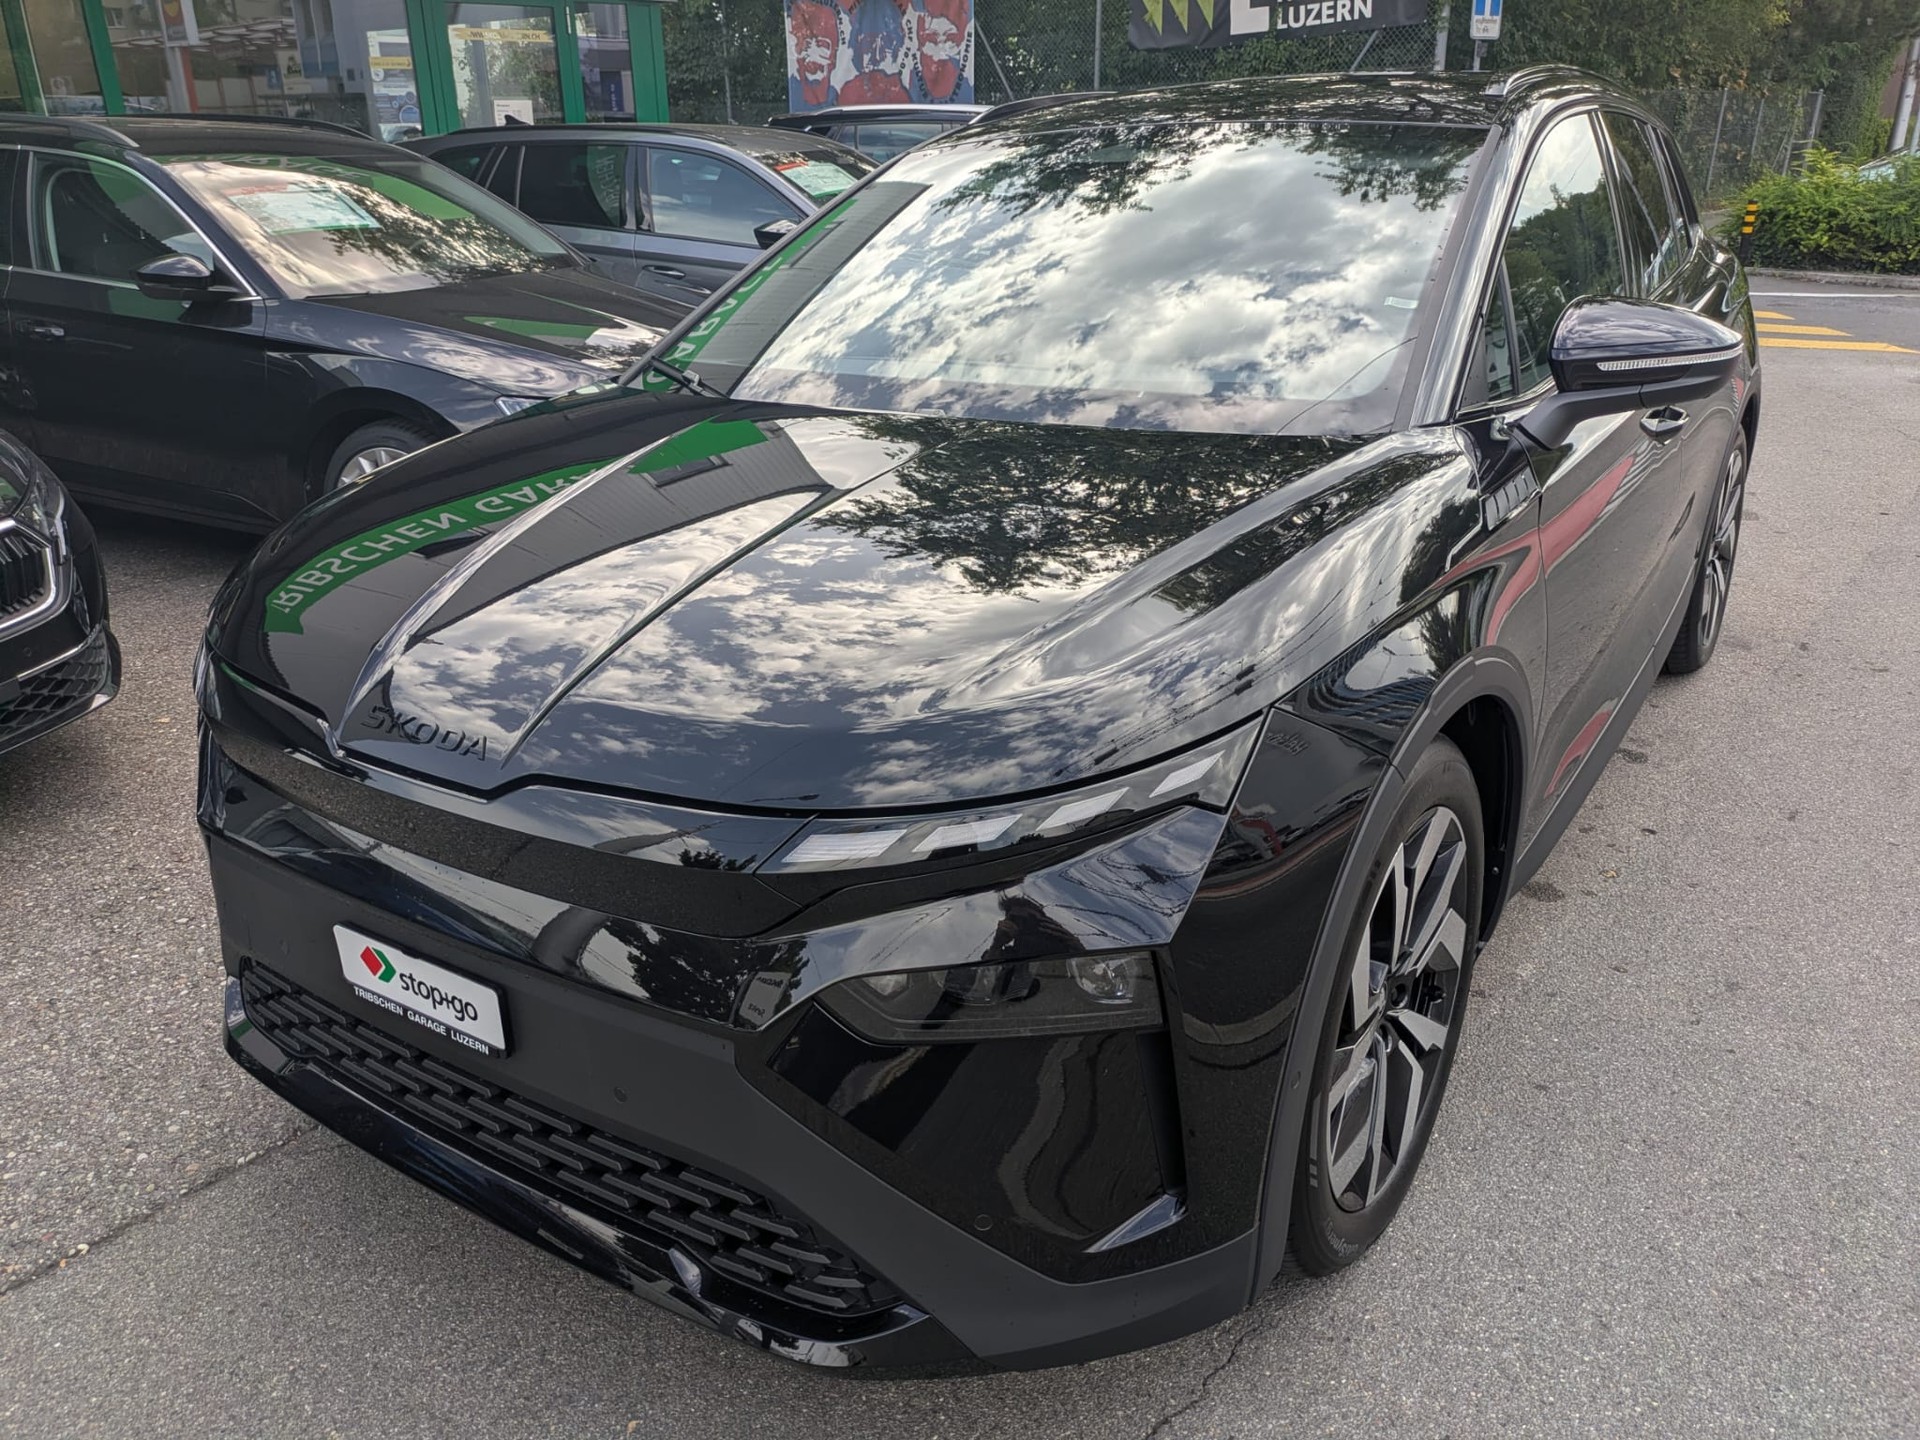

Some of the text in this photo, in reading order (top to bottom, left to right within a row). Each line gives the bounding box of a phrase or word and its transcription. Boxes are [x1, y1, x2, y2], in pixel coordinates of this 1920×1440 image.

[1276, 0, 1373, 29] LUZERN
[353, 986, 490, 1055] TRIBSCHEN GARAGE LUZERN
[399, 972, 478, 1022] stop+go
